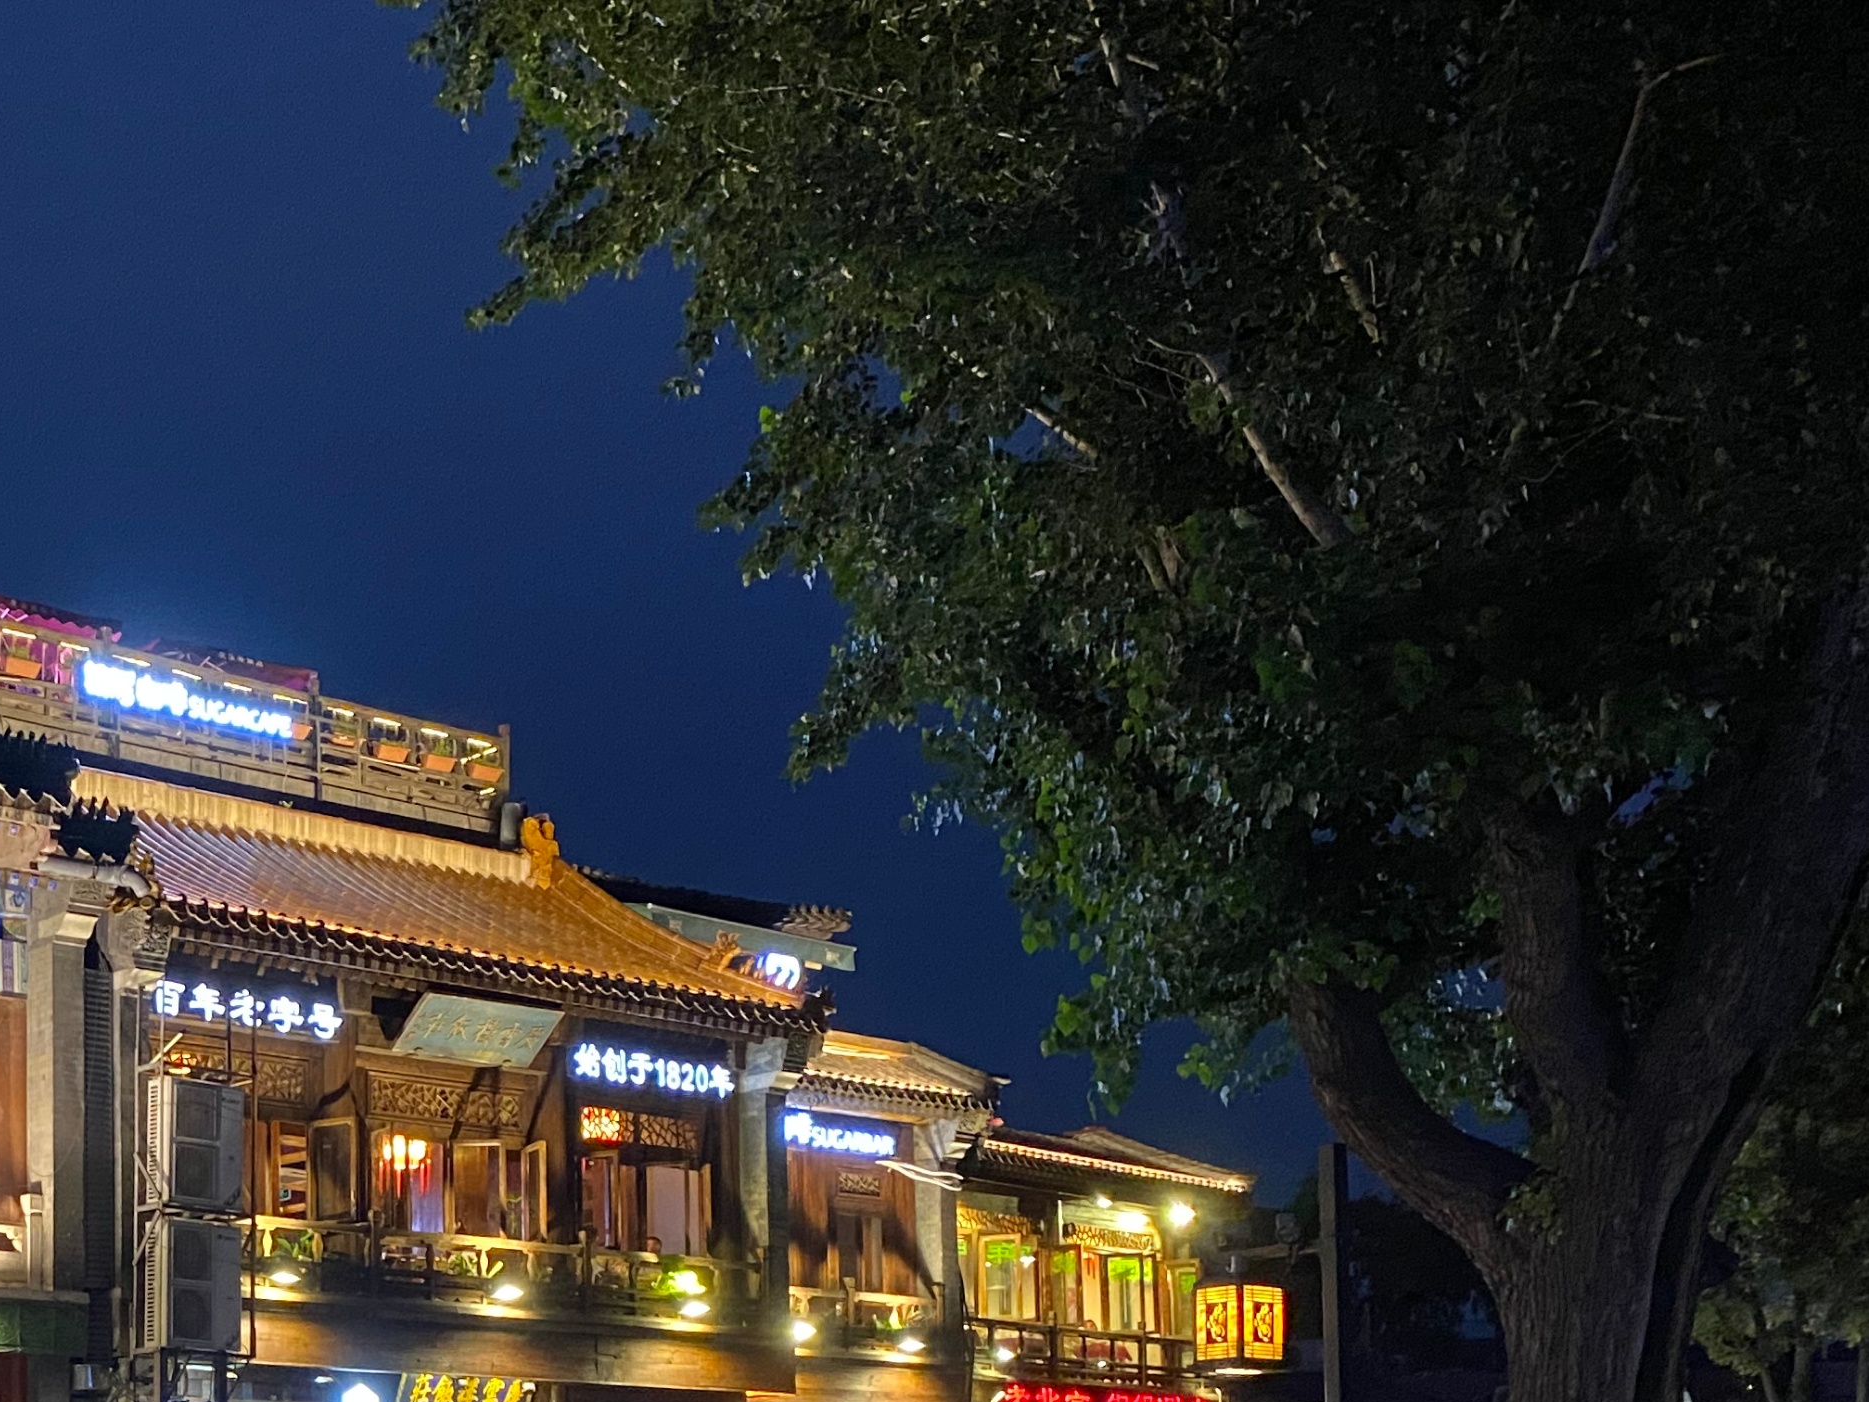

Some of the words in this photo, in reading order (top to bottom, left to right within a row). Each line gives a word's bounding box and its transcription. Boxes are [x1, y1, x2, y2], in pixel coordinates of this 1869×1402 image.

[154, 978, 343, 1040] 百年老字号
[572, 1043, 735, 1099] 始创于1820年
